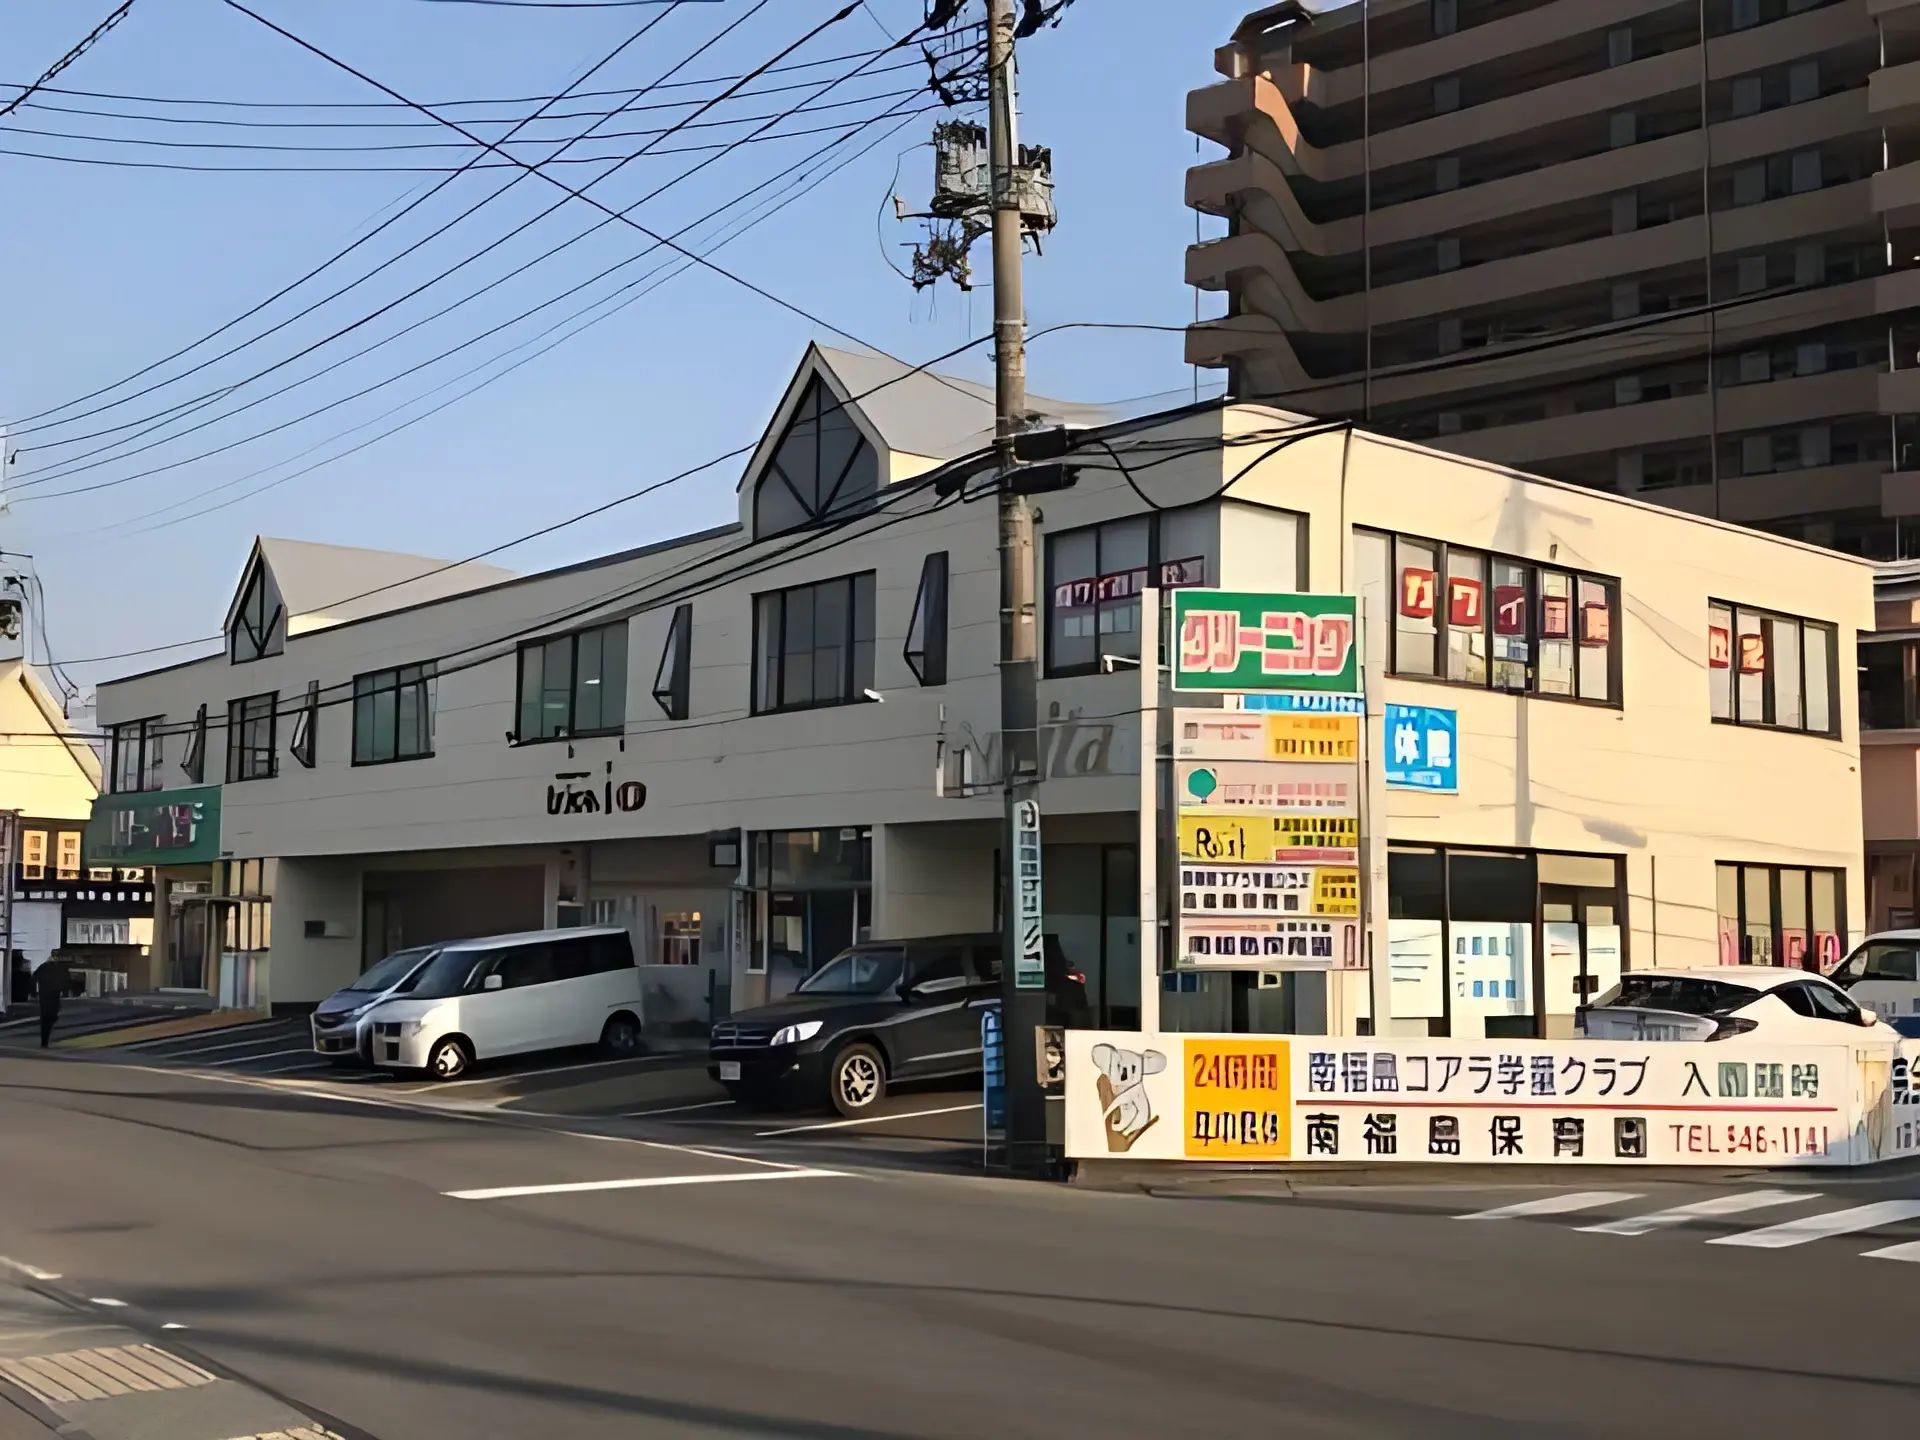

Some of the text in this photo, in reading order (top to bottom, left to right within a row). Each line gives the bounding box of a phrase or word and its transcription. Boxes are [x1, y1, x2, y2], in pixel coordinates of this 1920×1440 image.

[1180, 610, 1353, 676] クリーニング
[1669, 1124, 1720, 1153] TEL
